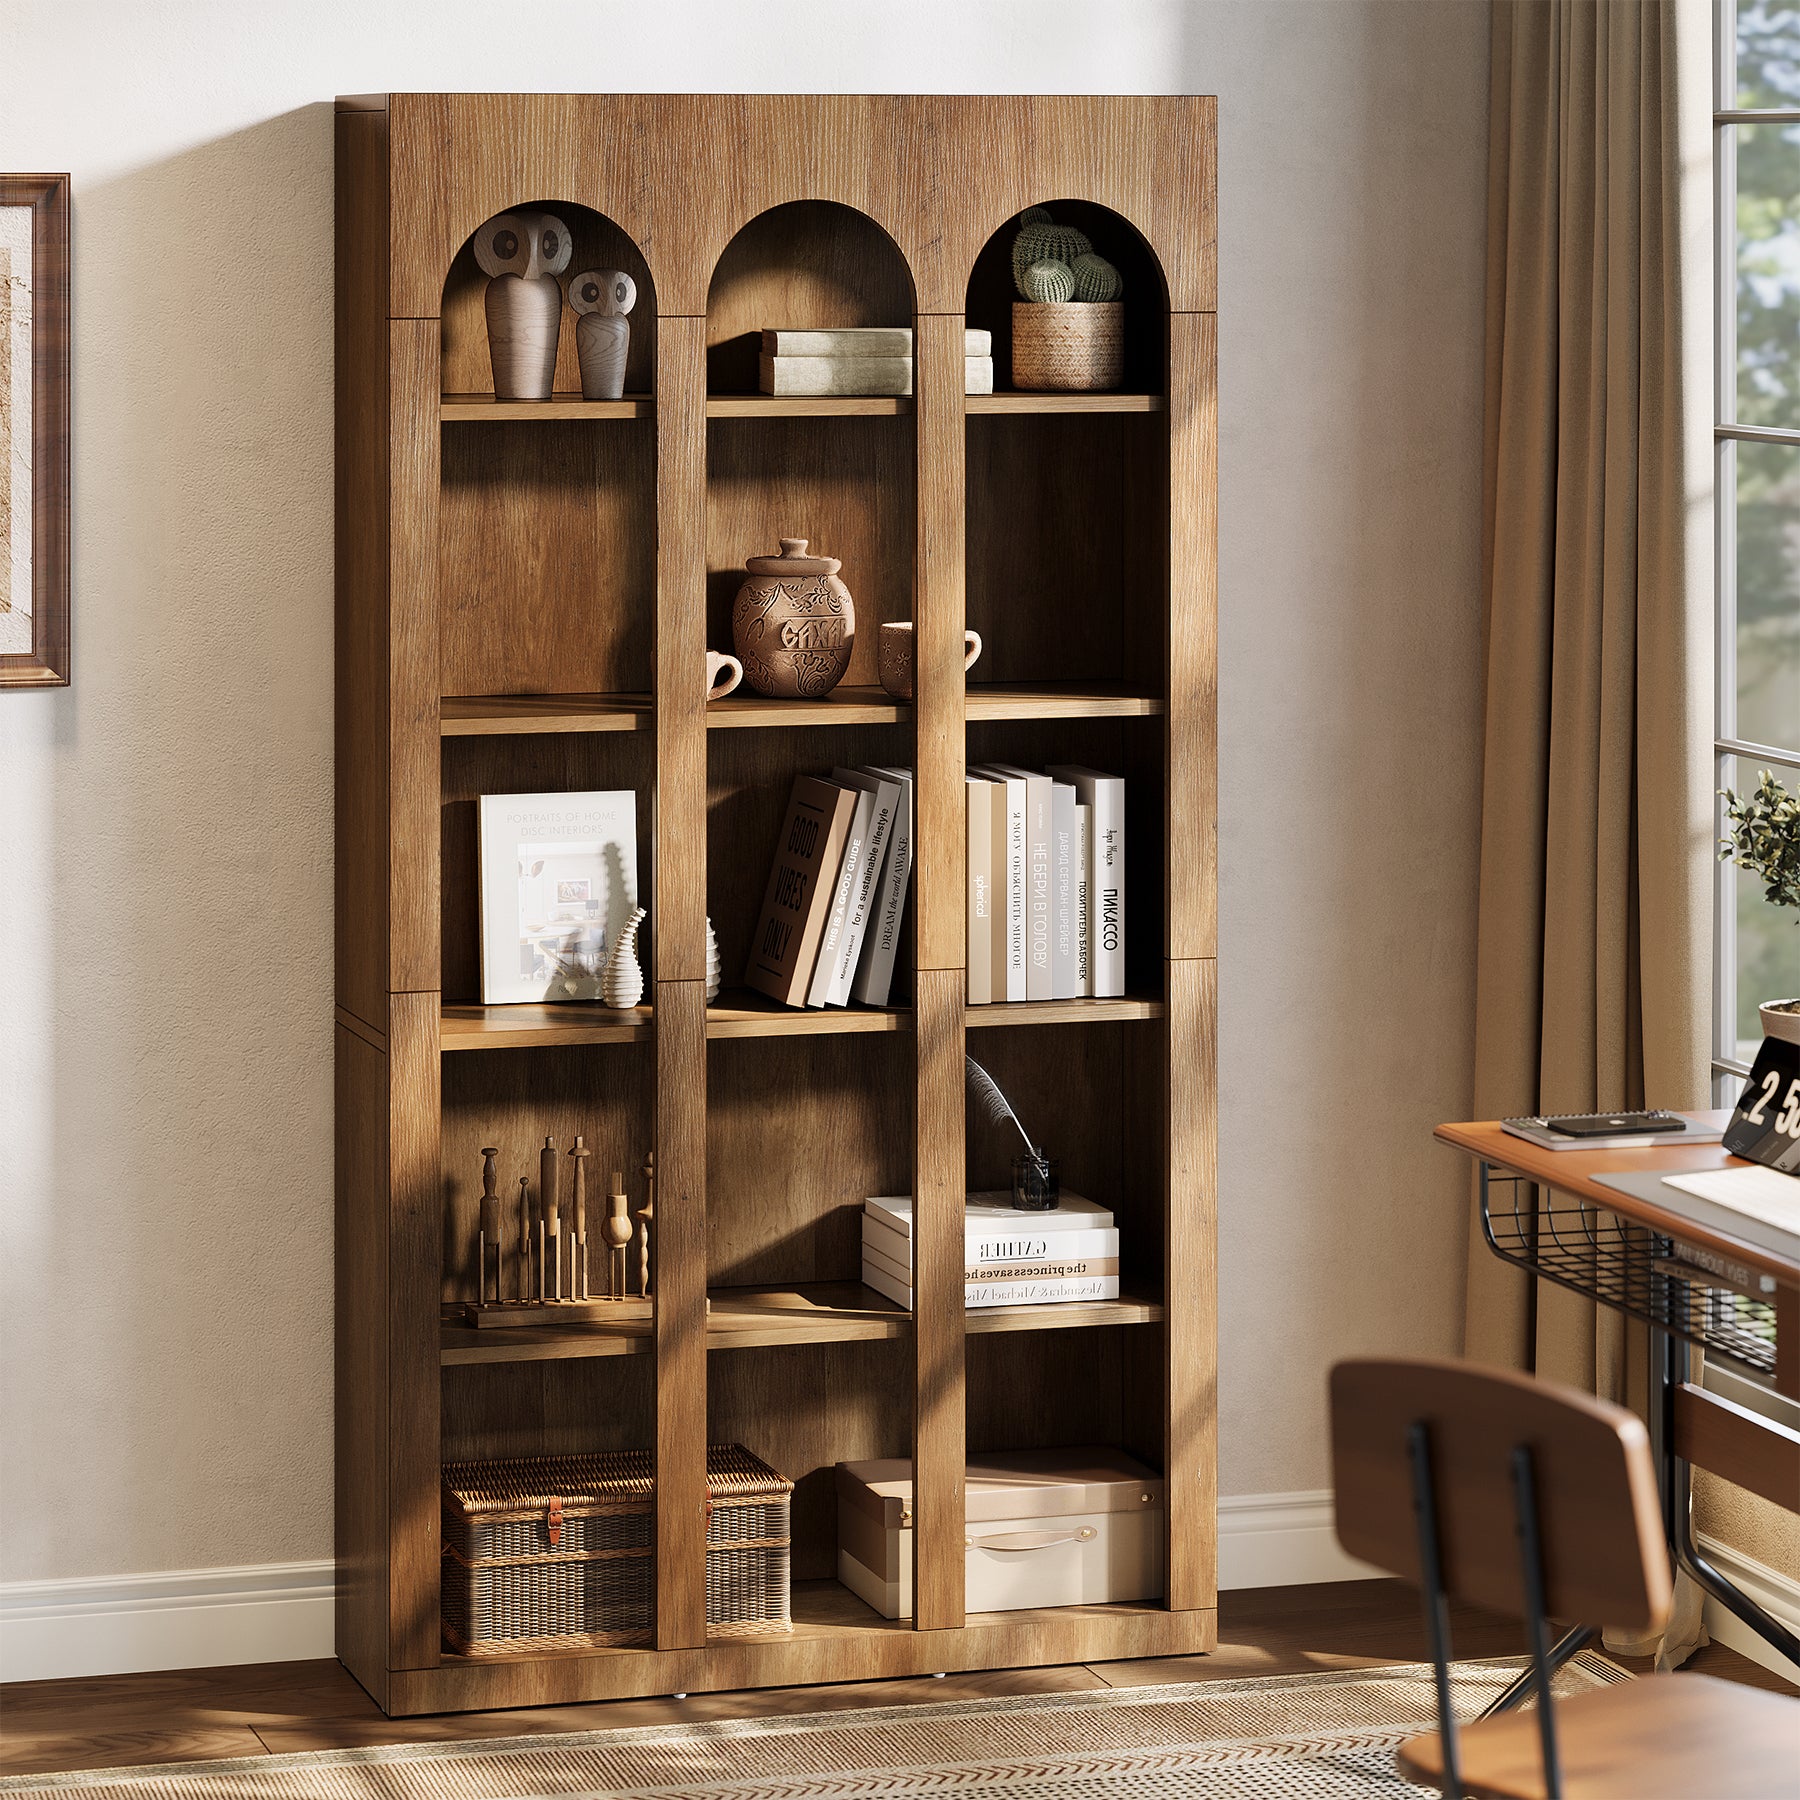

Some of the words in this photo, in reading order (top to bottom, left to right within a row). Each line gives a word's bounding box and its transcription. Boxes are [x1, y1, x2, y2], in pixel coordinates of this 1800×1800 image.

[506, 812, 561, 823] PORTRAITS
[565, 812, 581, 822] OF
[584, 810, 617, 821] HOME
[520, 826, 545, 836] DISC
[549, 824, 603, 835] INTERIORS
[788, 815, 819, 859] GOOD
[1013, 822, 1021, 851] МОГУ
[1033, 842, 1047, 859] НЕ
[1057, 832, 1069, 865] ДАВИД
[847, 839, 861, 871] GUIDE
[852, 912, 862, 926] for
[860, 847, 879, 902] sustainable
[872, 808, 889, 846] lifestyle
[895, 837, 908, 875] AWAKE
[775, 864, 807, 912] VIBES
[838, 873, 852, 905] GOOD
[892, 876, 902, 898] world
[973, 874, 988, 918] spherical
[1013, 856, 1021, 921] ОБЪЯСНИТЬ
[1033, 864, 1047, 899] БЕРИ
[833, 916, 842, 927] IS
[836, 907, 845, 915] A
[889, 897, 898, 910] the
[1034, 902, 1047, 911] В
[1058, 867, 1070, 956] СЕРВАН-ШРЕЙБЕР
[1078, 881, 1087, 938] ПОХИТИТЕЛЬ
[1103, 888, 1118, 951] ПИКАССО
[762, 917, 793, 962] ONLY
[826, 928, 839, 951] THIS
[881, 911, 896, 951] DREAM
[1013, 923, 1021, 970] МНОГОЕ
[1033, 914, 1047, 969] ГОЛОВУ
[1078, 940, 1087, 980] БАБОЧЕК
